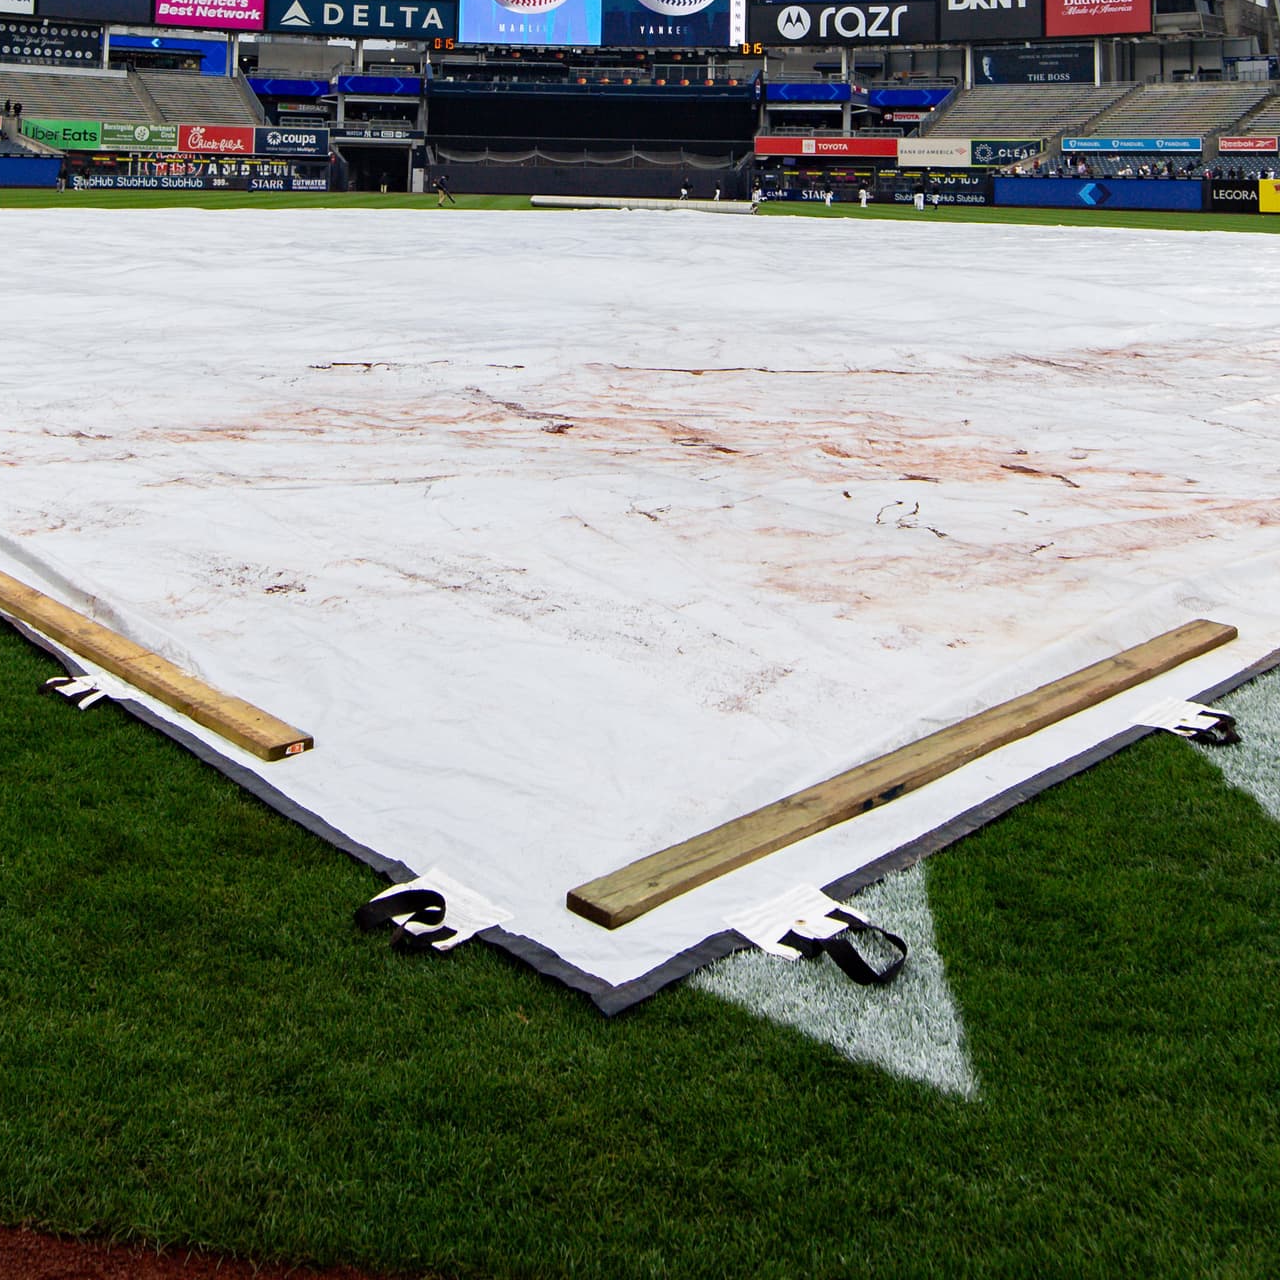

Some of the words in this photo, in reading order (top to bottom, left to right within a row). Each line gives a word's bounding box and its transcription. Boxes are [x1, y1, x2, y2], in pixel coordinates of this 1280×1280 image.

[159, 3, 194, 16] Best
[196, 6, 260, 20] Network
[1062, 5, 1089, 15] Made
[1089, 5, 1100, 16] of
[1100, 3, 1133, 14] America
[323, 3, 444, 29] DELTA
[820, 5, 908, 38] razr
[1027, 73, 1045, 81] THE
[1048, 72, 1070, 80] BOSS
[25, 126, 60, 141] Uber
[62, 128, 97, 142] Eats
[188, 129, 244, 151] Chick-fil-A
[282, 133, 316, 146] coupa
[817, 143, 848, 151] TOYOTA
[1220, 139, 1254, 148] Reebok
[116, 177, 158, 188] StubHub
[161, 177, 203, 188] StubHub
[252, 178, 284, 190] STARR
[292, 178, 327, 186] CUTWATER
[956, 193, 985, 203] StubHub
[1213, 189, 1258, 201] LEGORA
